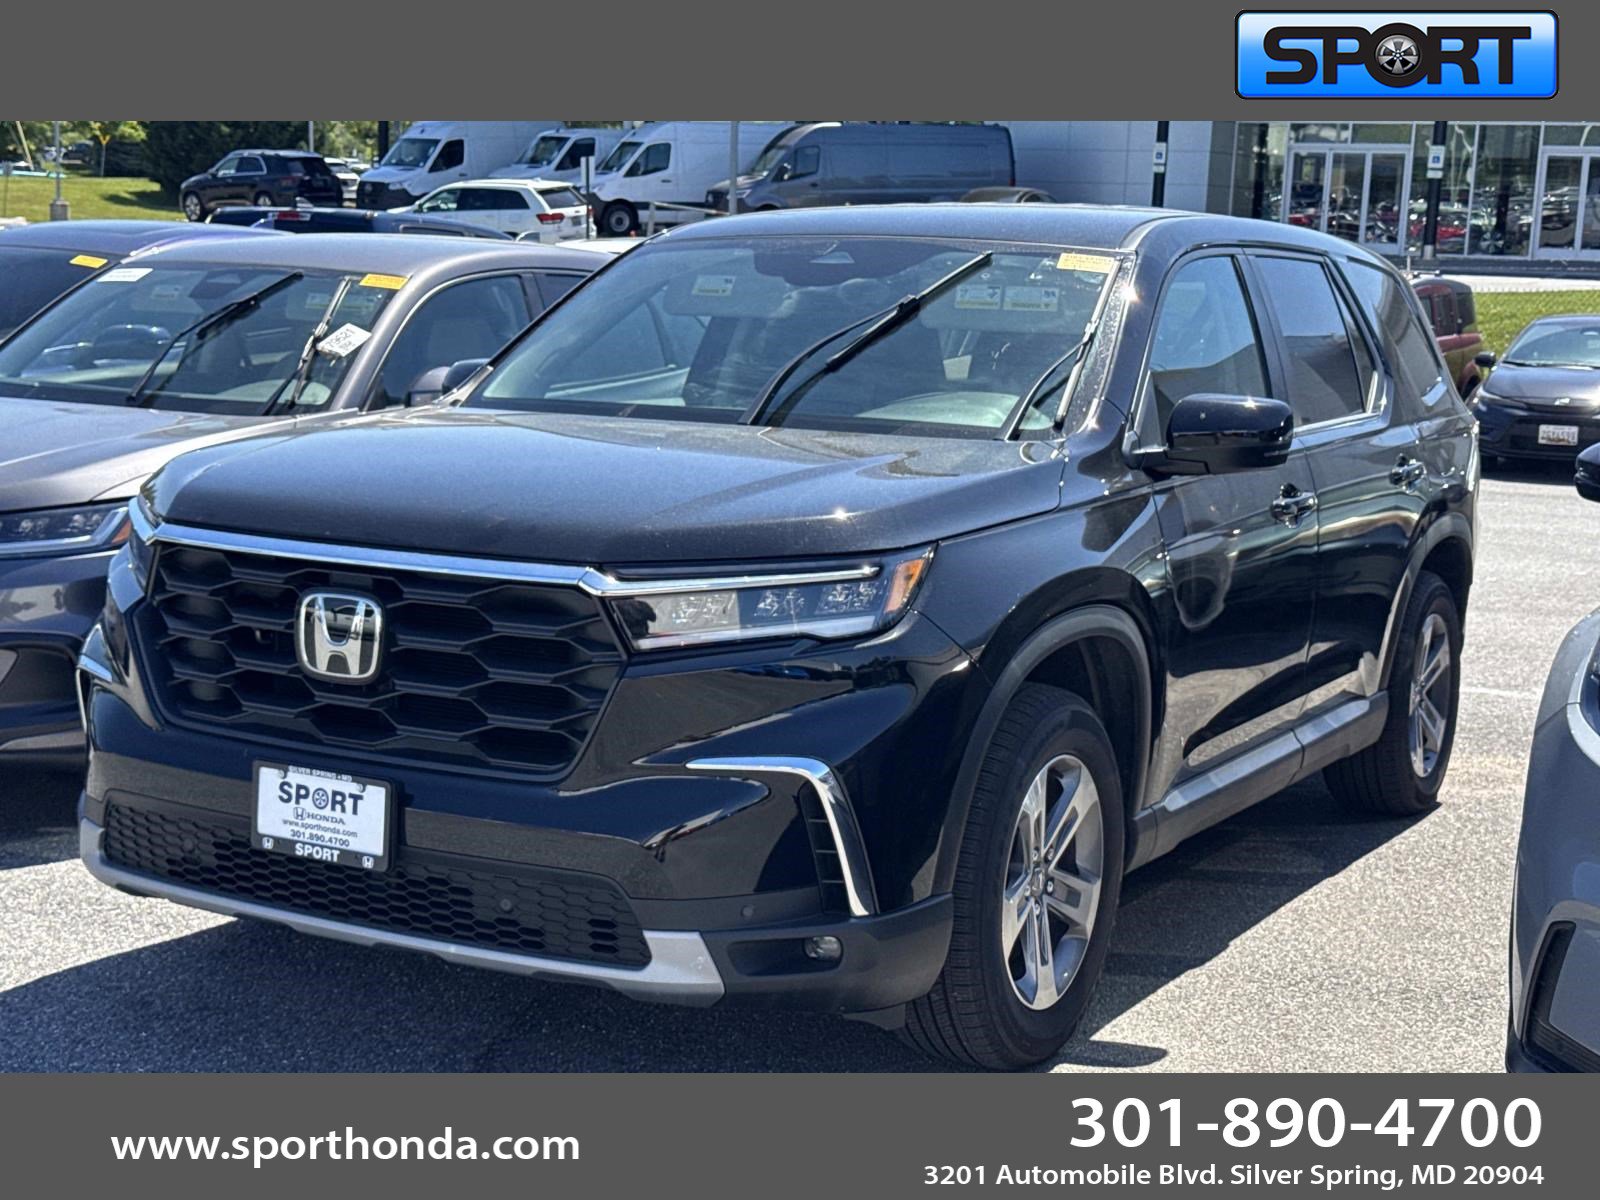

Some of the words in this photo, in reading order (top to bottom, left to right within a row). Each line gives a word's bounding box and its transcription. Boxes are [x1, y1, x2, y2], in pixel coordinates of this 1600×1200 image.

[278, 781, 364, 816] SPORT
[306, 811, 346, 826] HONDA
[282, 819, 358, 838] www.sporthonda.com
[290, 829, 350, 848] 301.890.4700
[295, 844, 340, 862] SPORT
